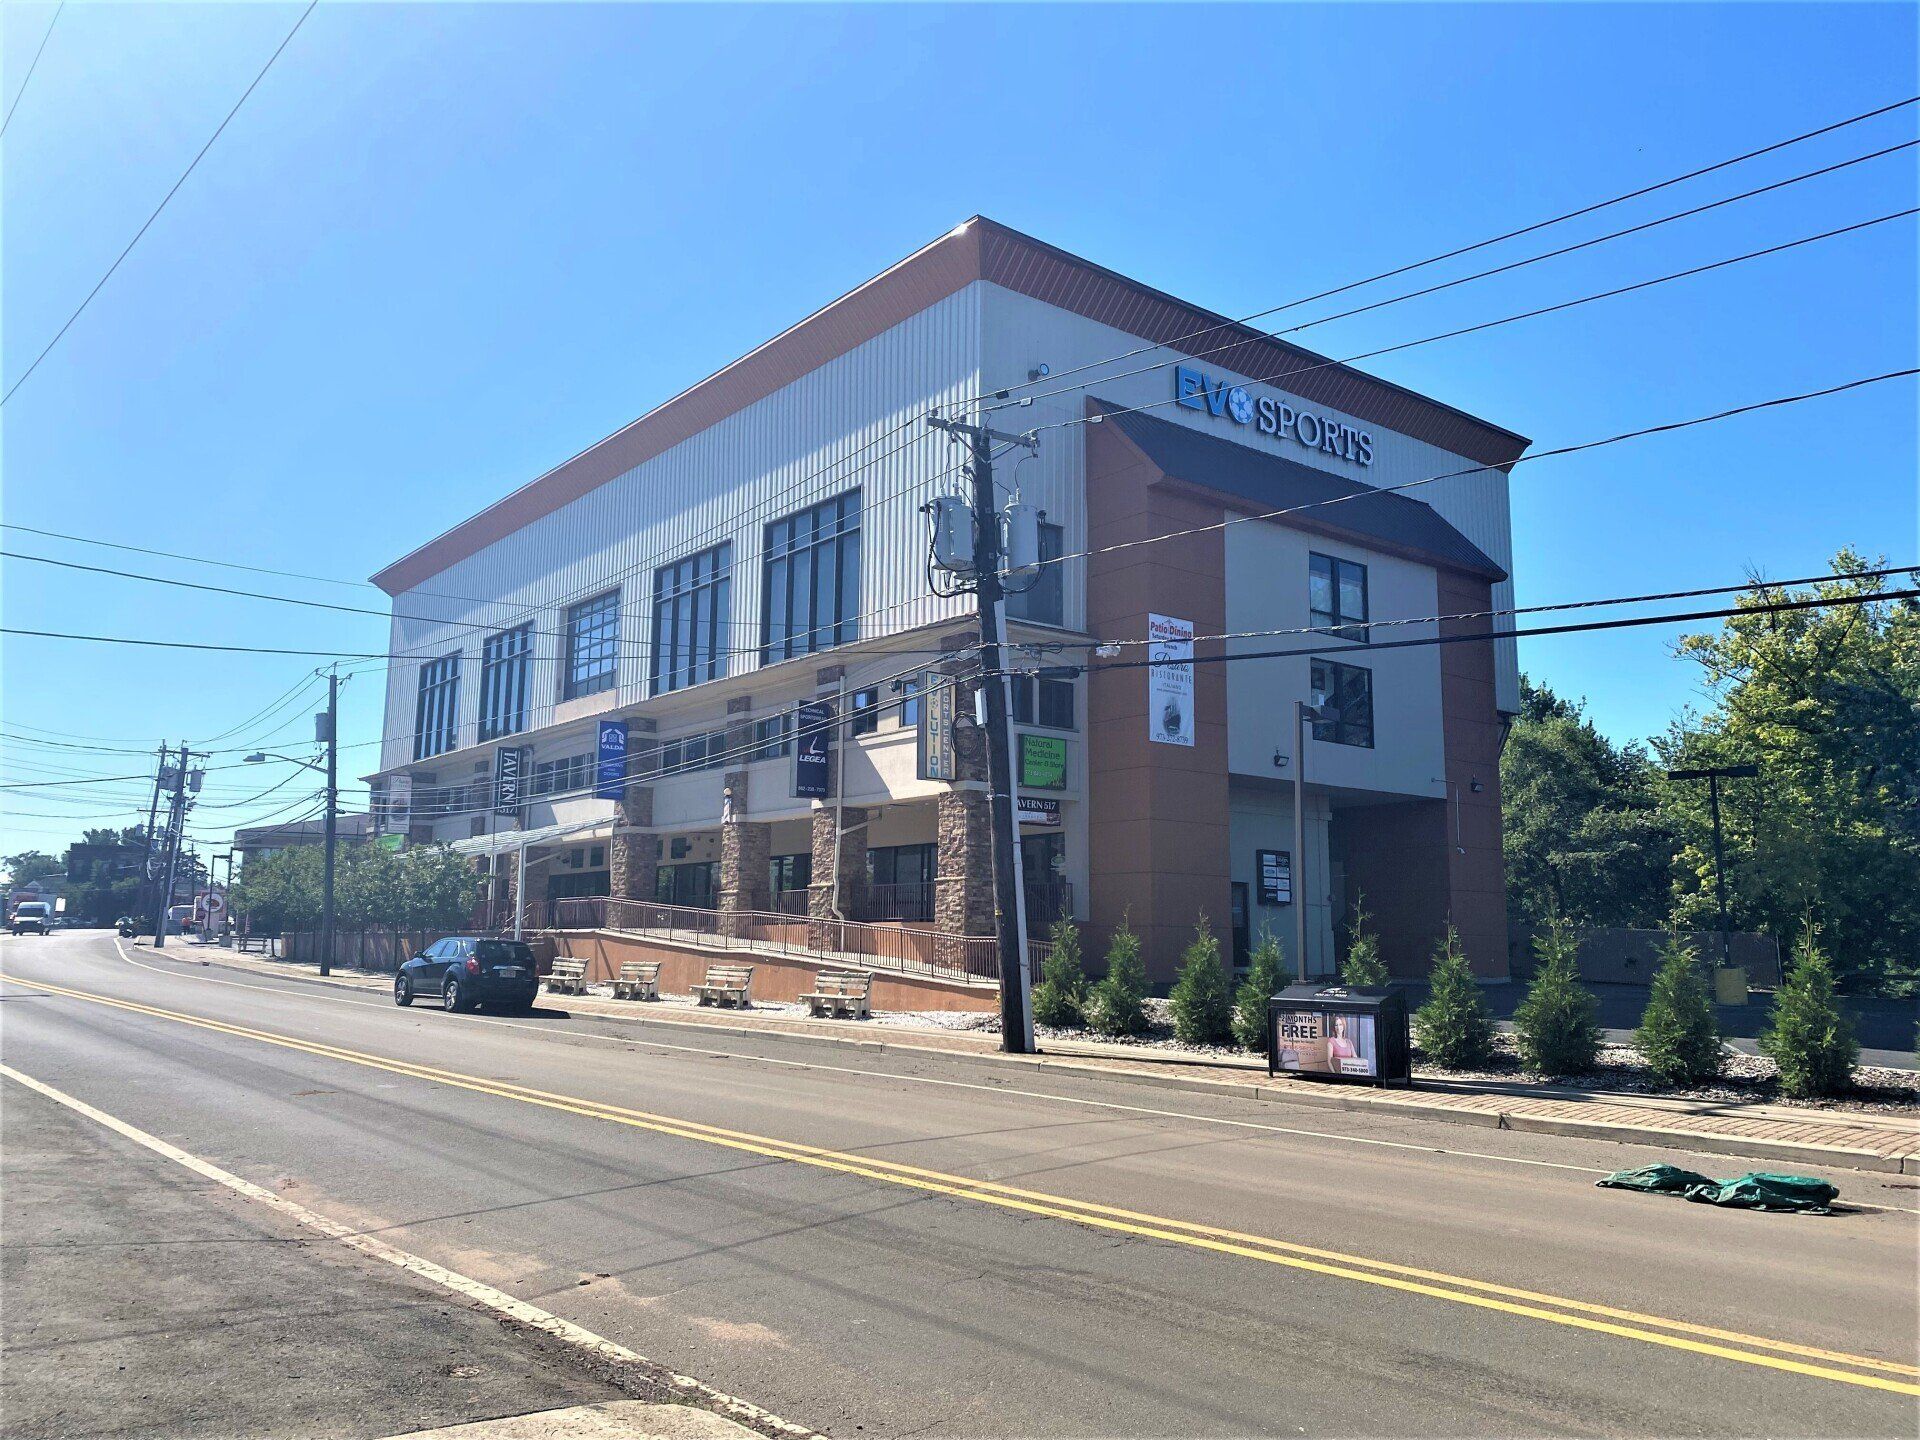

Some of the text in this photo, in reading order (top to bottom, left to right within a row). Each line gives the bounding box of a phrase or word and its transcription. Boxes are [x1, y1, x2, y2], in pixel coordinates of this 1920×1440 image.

[1258, 396, 1374, 467] SPORTS
[1150, 621, 1193, 639] Patio Dining
[1151, 668, 1192, 685] RISTORANTE
[1025, 736, 1053, 749] Natural
[799, 754, 826, 763] LEGEA
[1025, 748, 1061, 760] Medicine
[502, 751, 518, 803] TAVERN
[1043, 801, 1056, 810] 517
[1286, 1014, 1317, 1024] MONTHS
[1281, 1024, 1318, 1040] FREE
